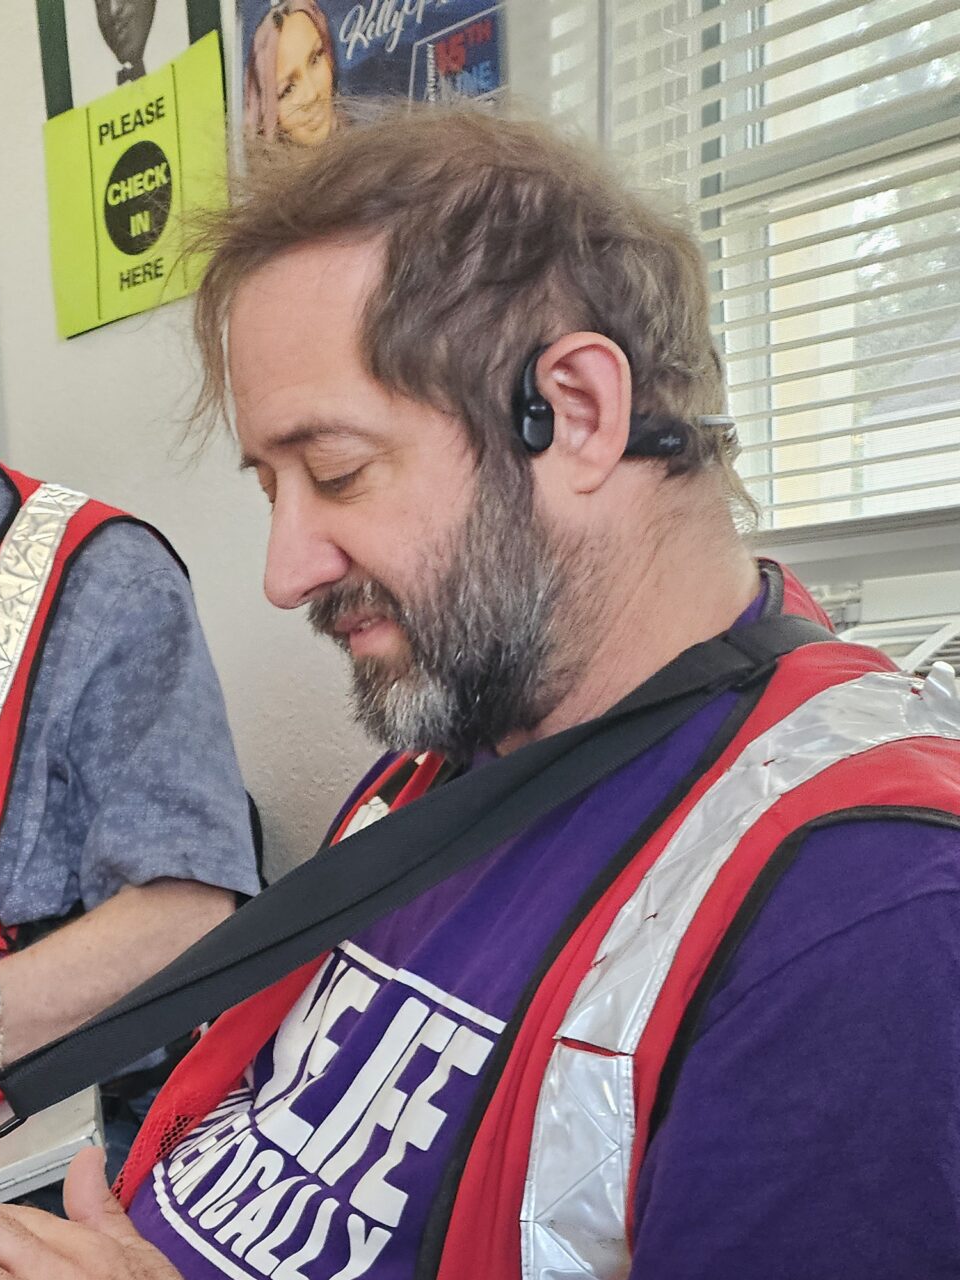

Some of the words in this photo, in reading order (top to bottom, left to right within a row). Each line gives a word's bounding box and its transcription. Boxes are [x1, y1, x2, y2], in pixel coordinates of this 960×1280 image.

[98, 96, 166, 145] PLEASE
[107, 162, 169, 206] CHECK
[130, 211, 150, 237] IN
[118, 258, 165, 291] HERE
